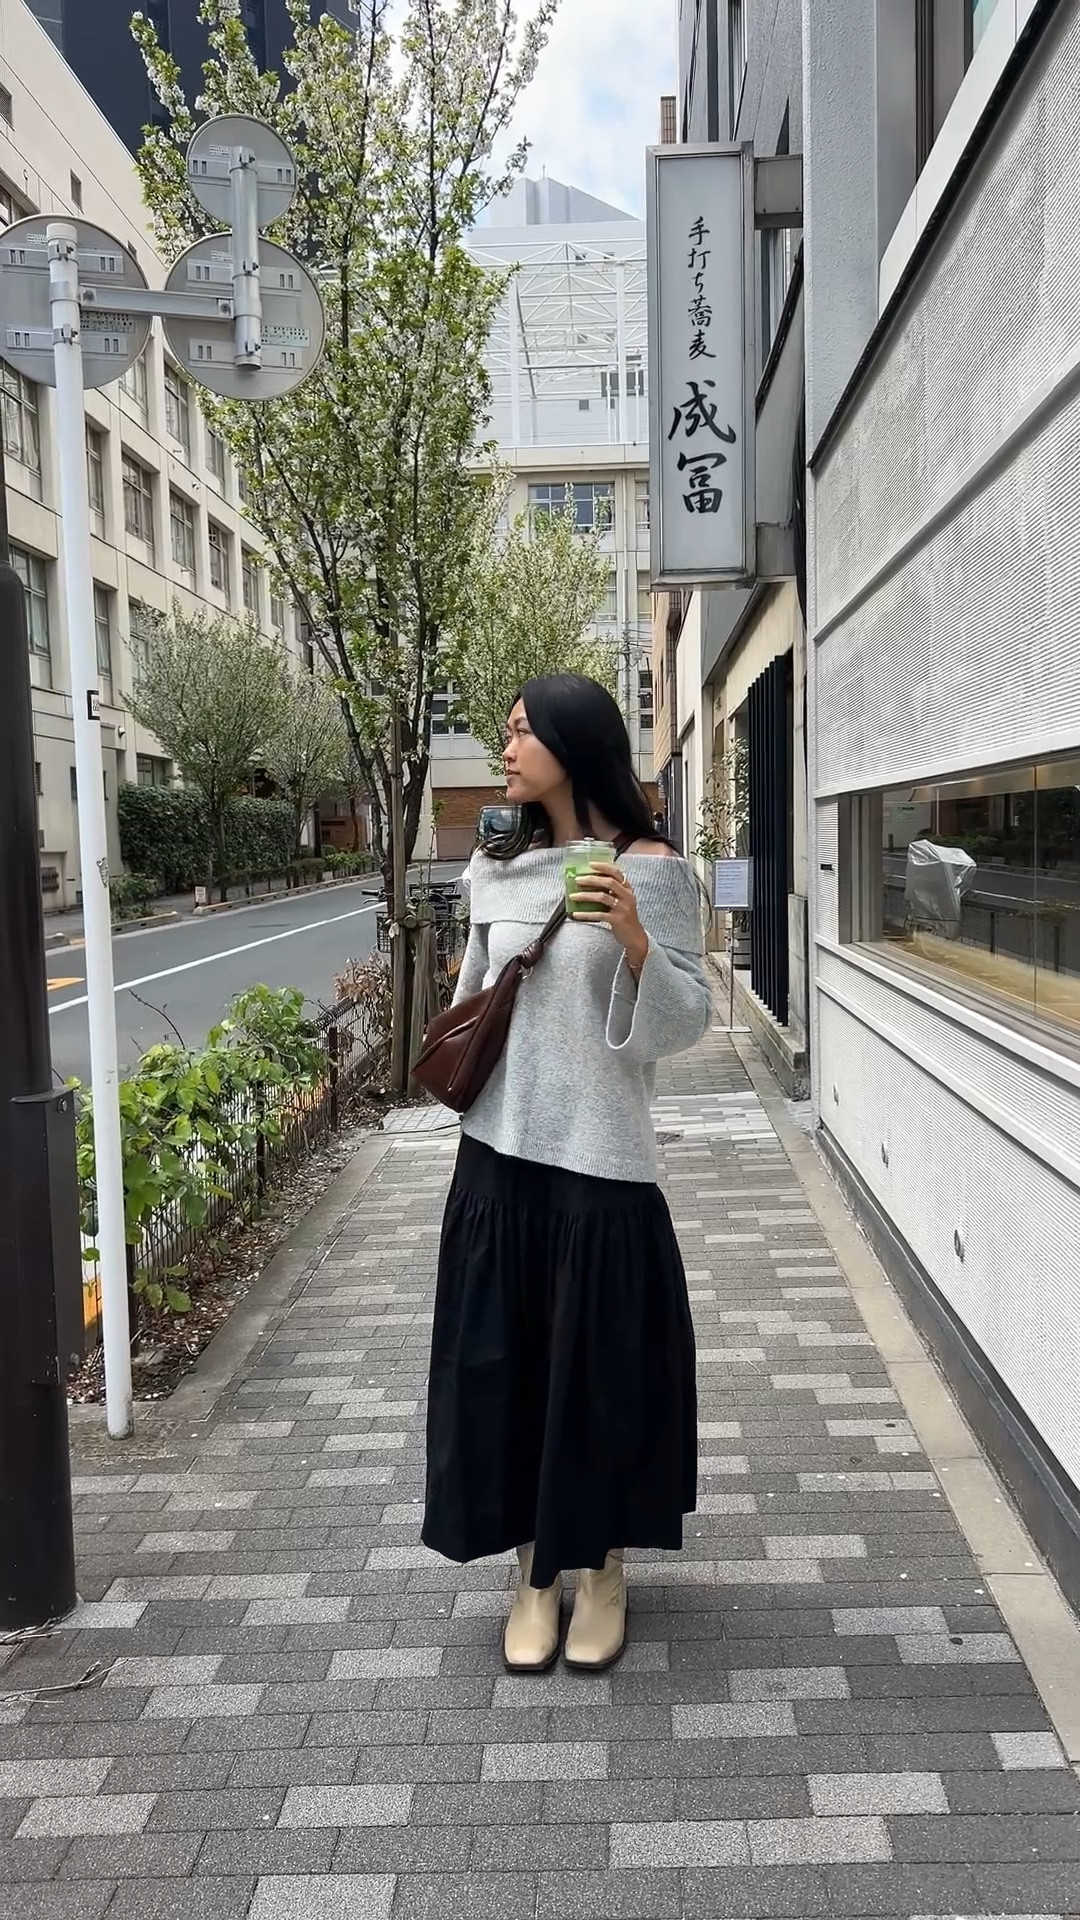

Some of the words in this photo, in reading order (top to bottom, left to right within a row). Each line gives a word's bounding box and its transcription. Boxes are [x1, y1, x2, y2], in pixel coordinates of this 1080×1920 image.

[687, 215, 717, 360] 手打ち蕎麦
